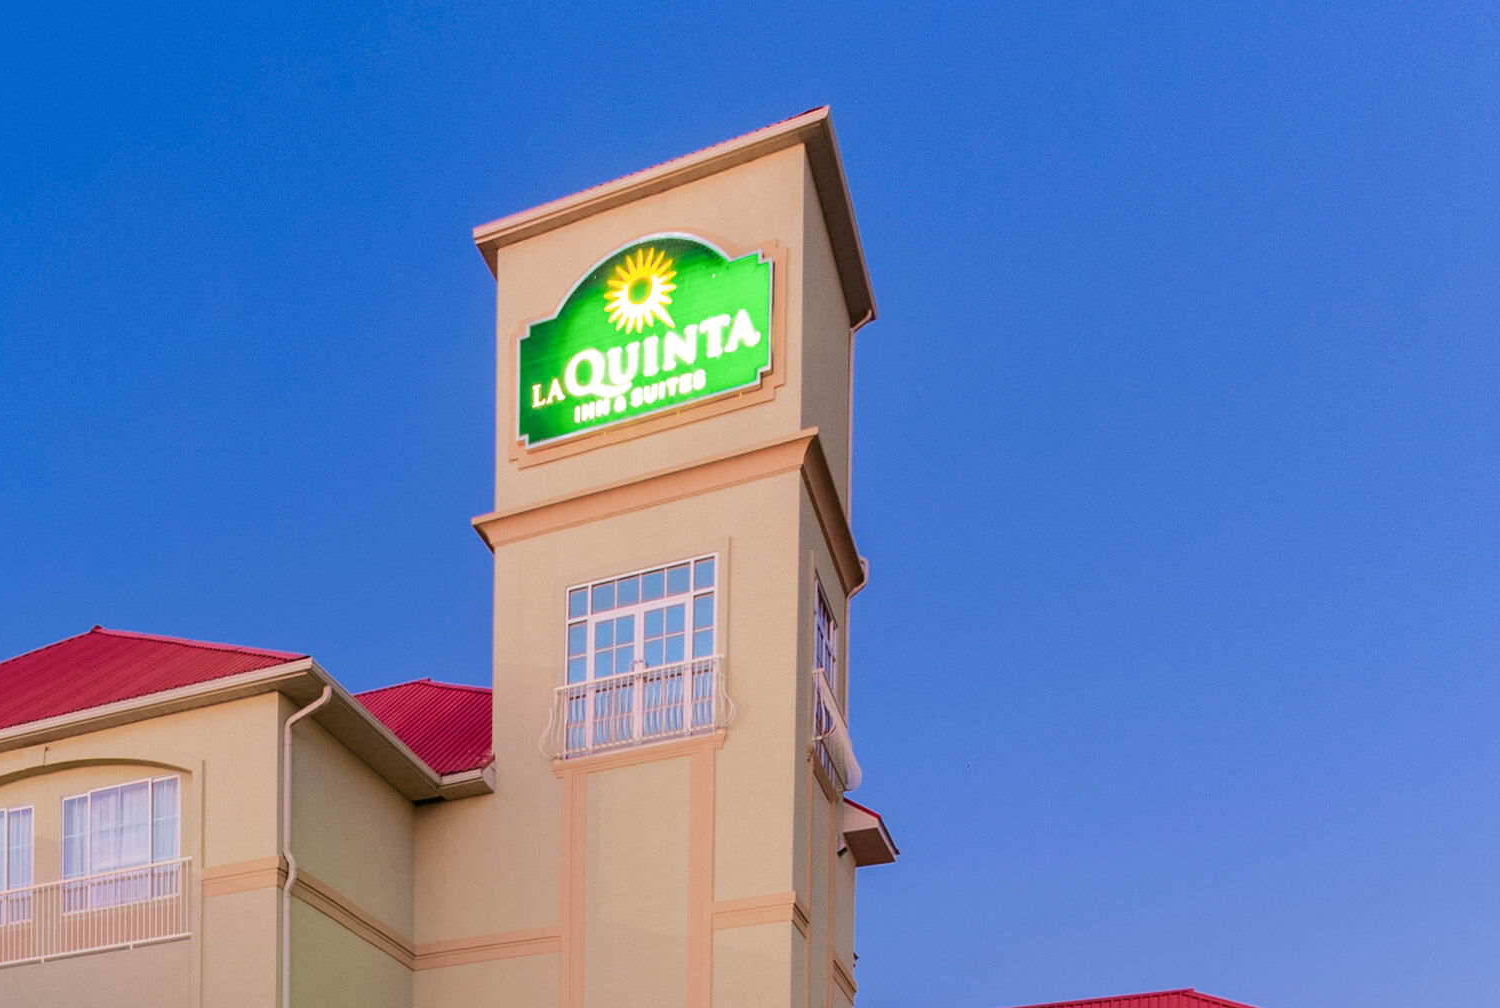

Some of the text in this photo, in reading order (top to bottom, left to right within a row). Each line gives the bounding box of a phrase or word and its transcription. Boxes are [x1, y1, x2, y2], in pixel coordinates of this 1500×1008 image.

[531, 309, 761, 408] LA QUINTA
[574, 398, 610, 423] INN
[630, 369, 706, 407] SUITES
